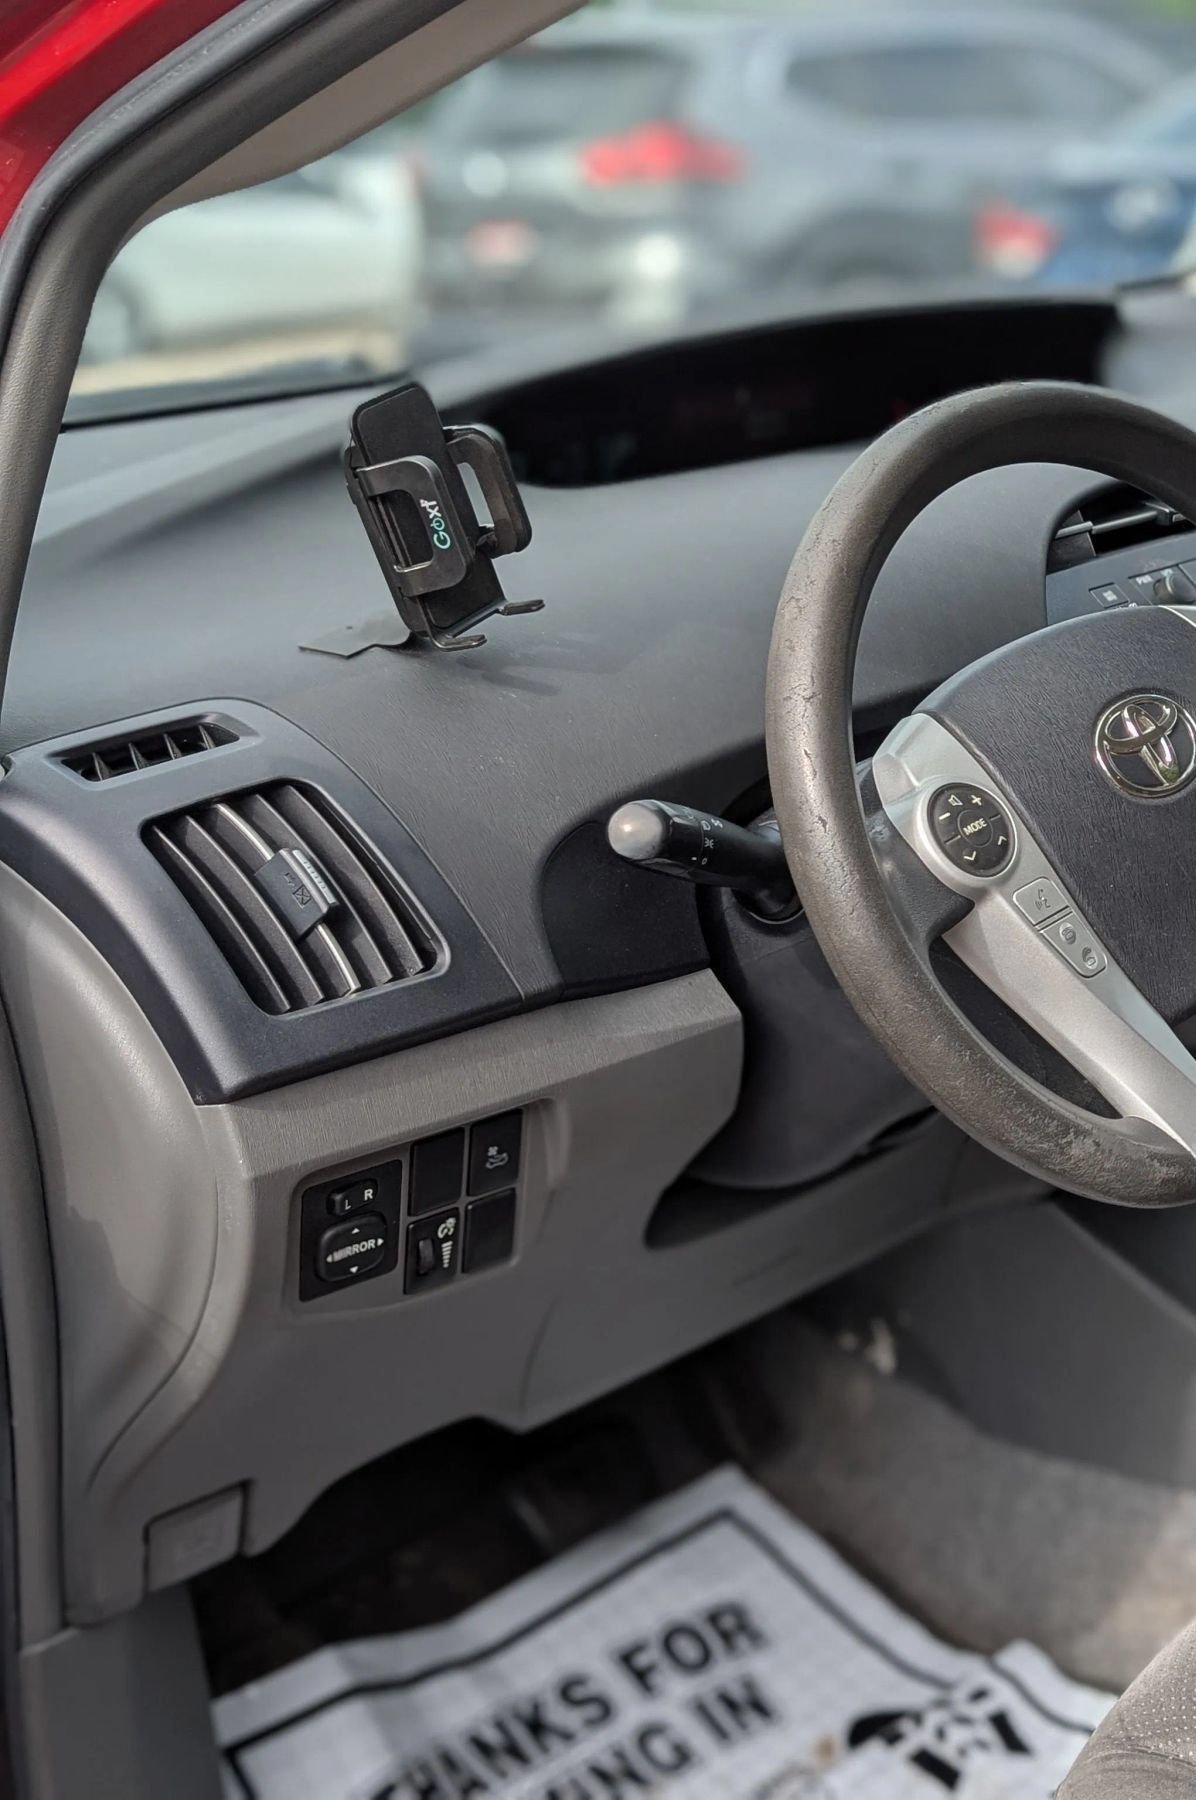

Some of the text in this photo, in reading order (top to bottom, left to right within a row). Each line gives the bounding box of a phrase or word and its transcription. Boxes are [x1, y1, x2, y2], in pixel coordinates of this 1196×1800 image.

[963, 817, 988, 836] MODE
[344, 1188, 374, 1210] L R
[332, 1237, 376, 1262] MIRROR
[368, 1602, 768, 1800] HANKS FOR
[695, 1676, 778, 1744] IN
